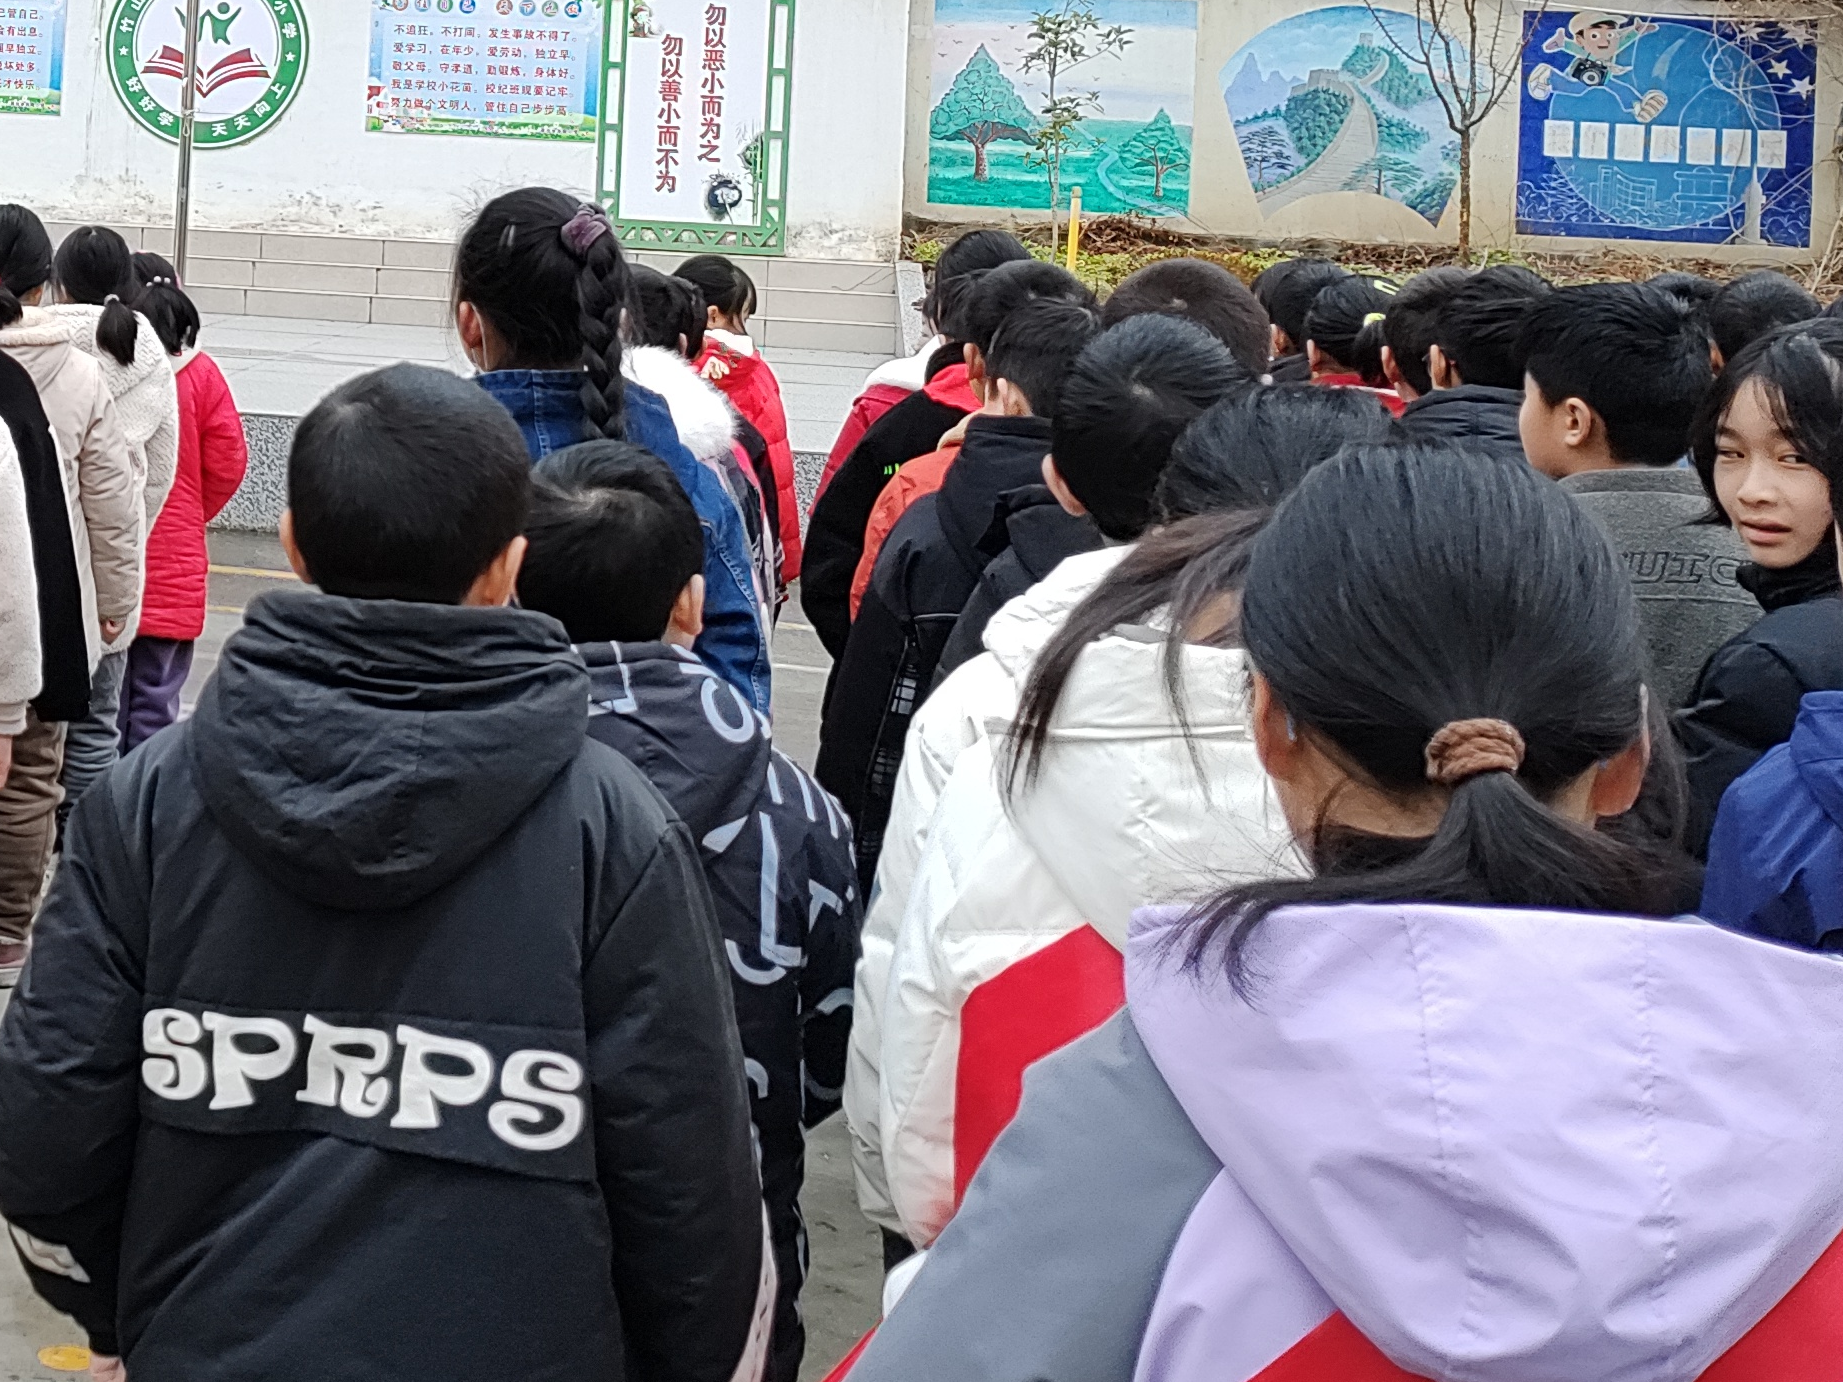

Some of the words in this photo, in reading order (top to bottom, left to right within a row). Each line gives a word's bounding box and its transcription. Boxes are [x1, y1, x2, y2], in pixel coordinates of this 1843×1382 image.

[211, 83, 287, 137] 天天向上
[654, 33, 684, 194] 勿以善小而不为
[696, 2, 727, 163] 勿以恶小而为之
[140, 1007, 585, 1152] SPRPS
